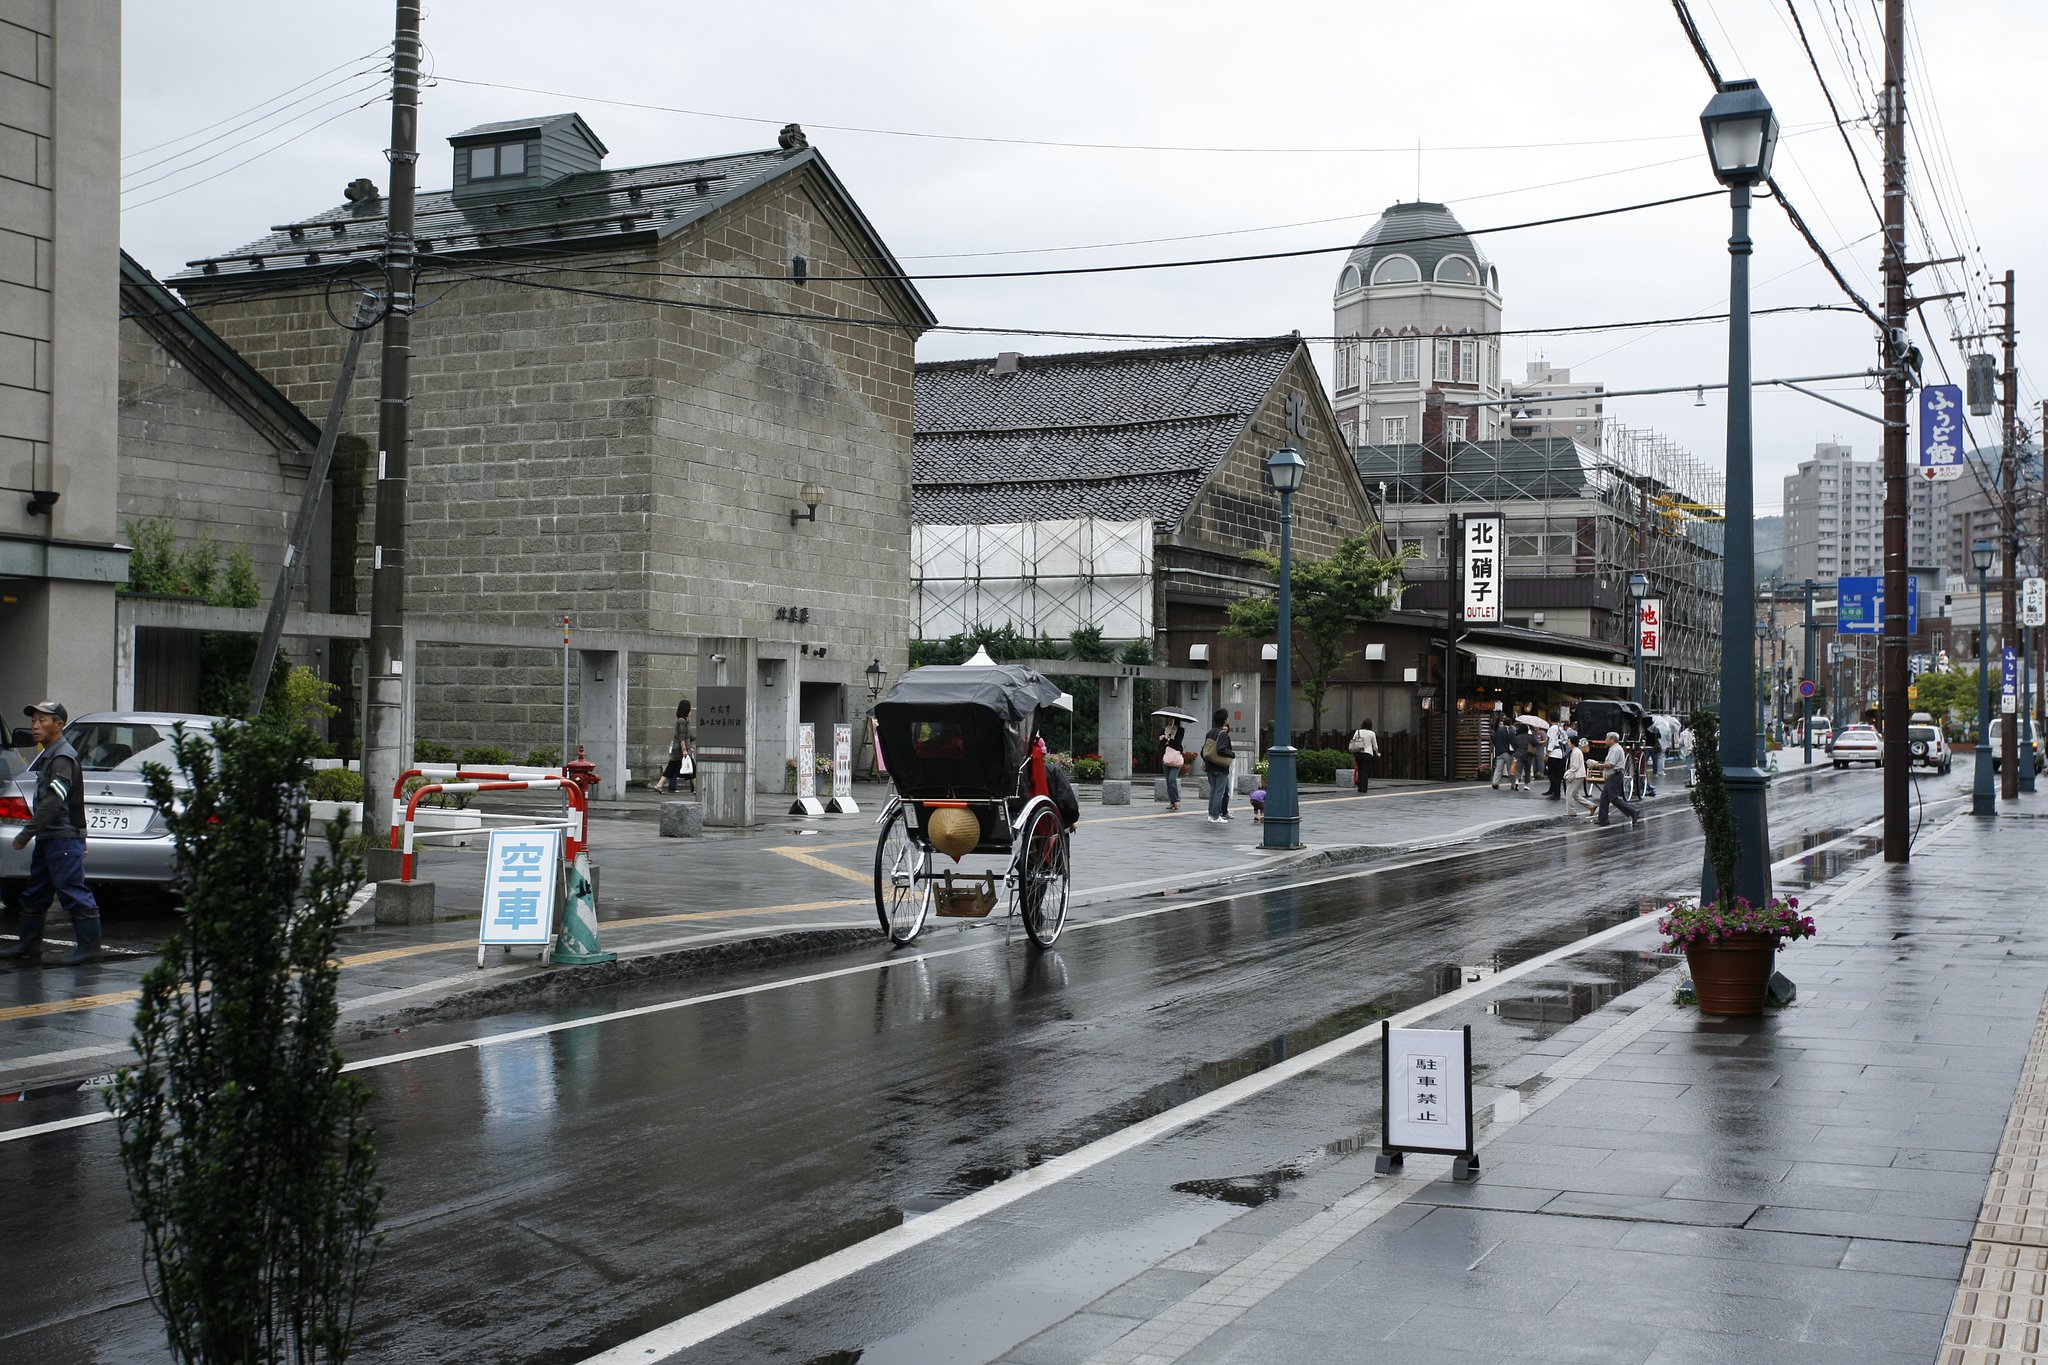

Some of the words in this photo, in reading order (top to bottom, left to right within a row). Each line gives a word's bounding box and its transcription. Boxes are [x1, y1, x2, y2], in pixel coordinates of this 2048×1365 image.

[1925, 390, 1957, 465] ふうど館
[1471, 522, 1493, 602] 北一硝子
[1467, 607, 1495, 618] OUTLET
[90, 816, 128, 829] 25-79
[494, 842, 545, 931] 空車
[1416, 1058, 1438, 1122] 駐車禁止
